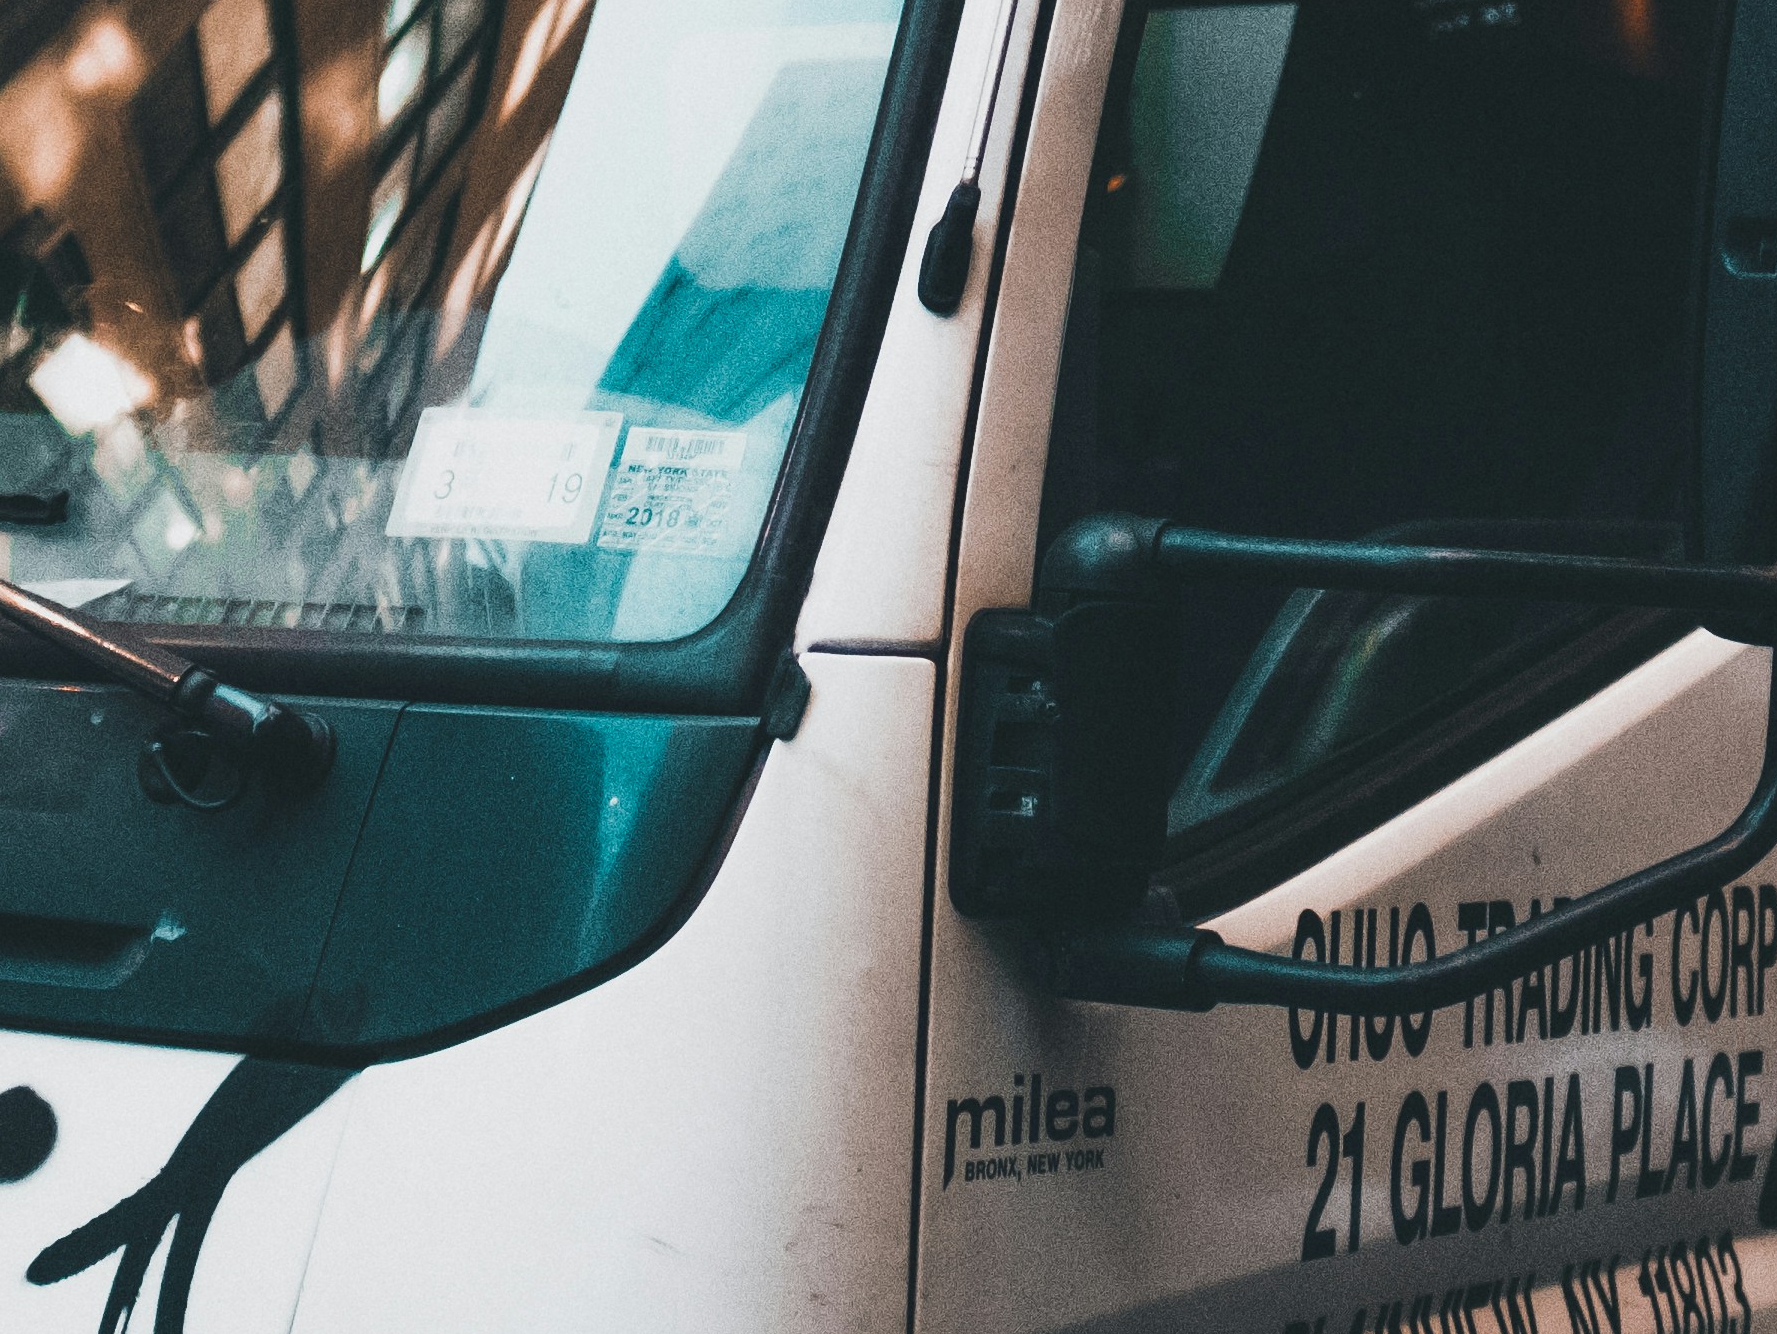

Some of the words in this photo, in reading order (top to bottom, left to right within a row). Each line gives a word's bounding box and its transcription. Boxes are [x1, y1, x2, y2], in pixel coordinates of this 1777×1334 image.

[433, 468, 456, 500] 3
[546, 472, 583, 504] 19
[625, 506, 681, 528] 2018
[1457, 896, 1654, 1049] TRADING
[943, 1072, 1117, 1193] milea
[1026, 1152, 1062, 1176] NEW
[1065, 1148, 1105, 1171] YORK
[1301, 1101, 1367, 1262] 21
[1389, 1072, 1587, 1247] GLORIA
[1606, 1050, 1764, 1205] PLACE
